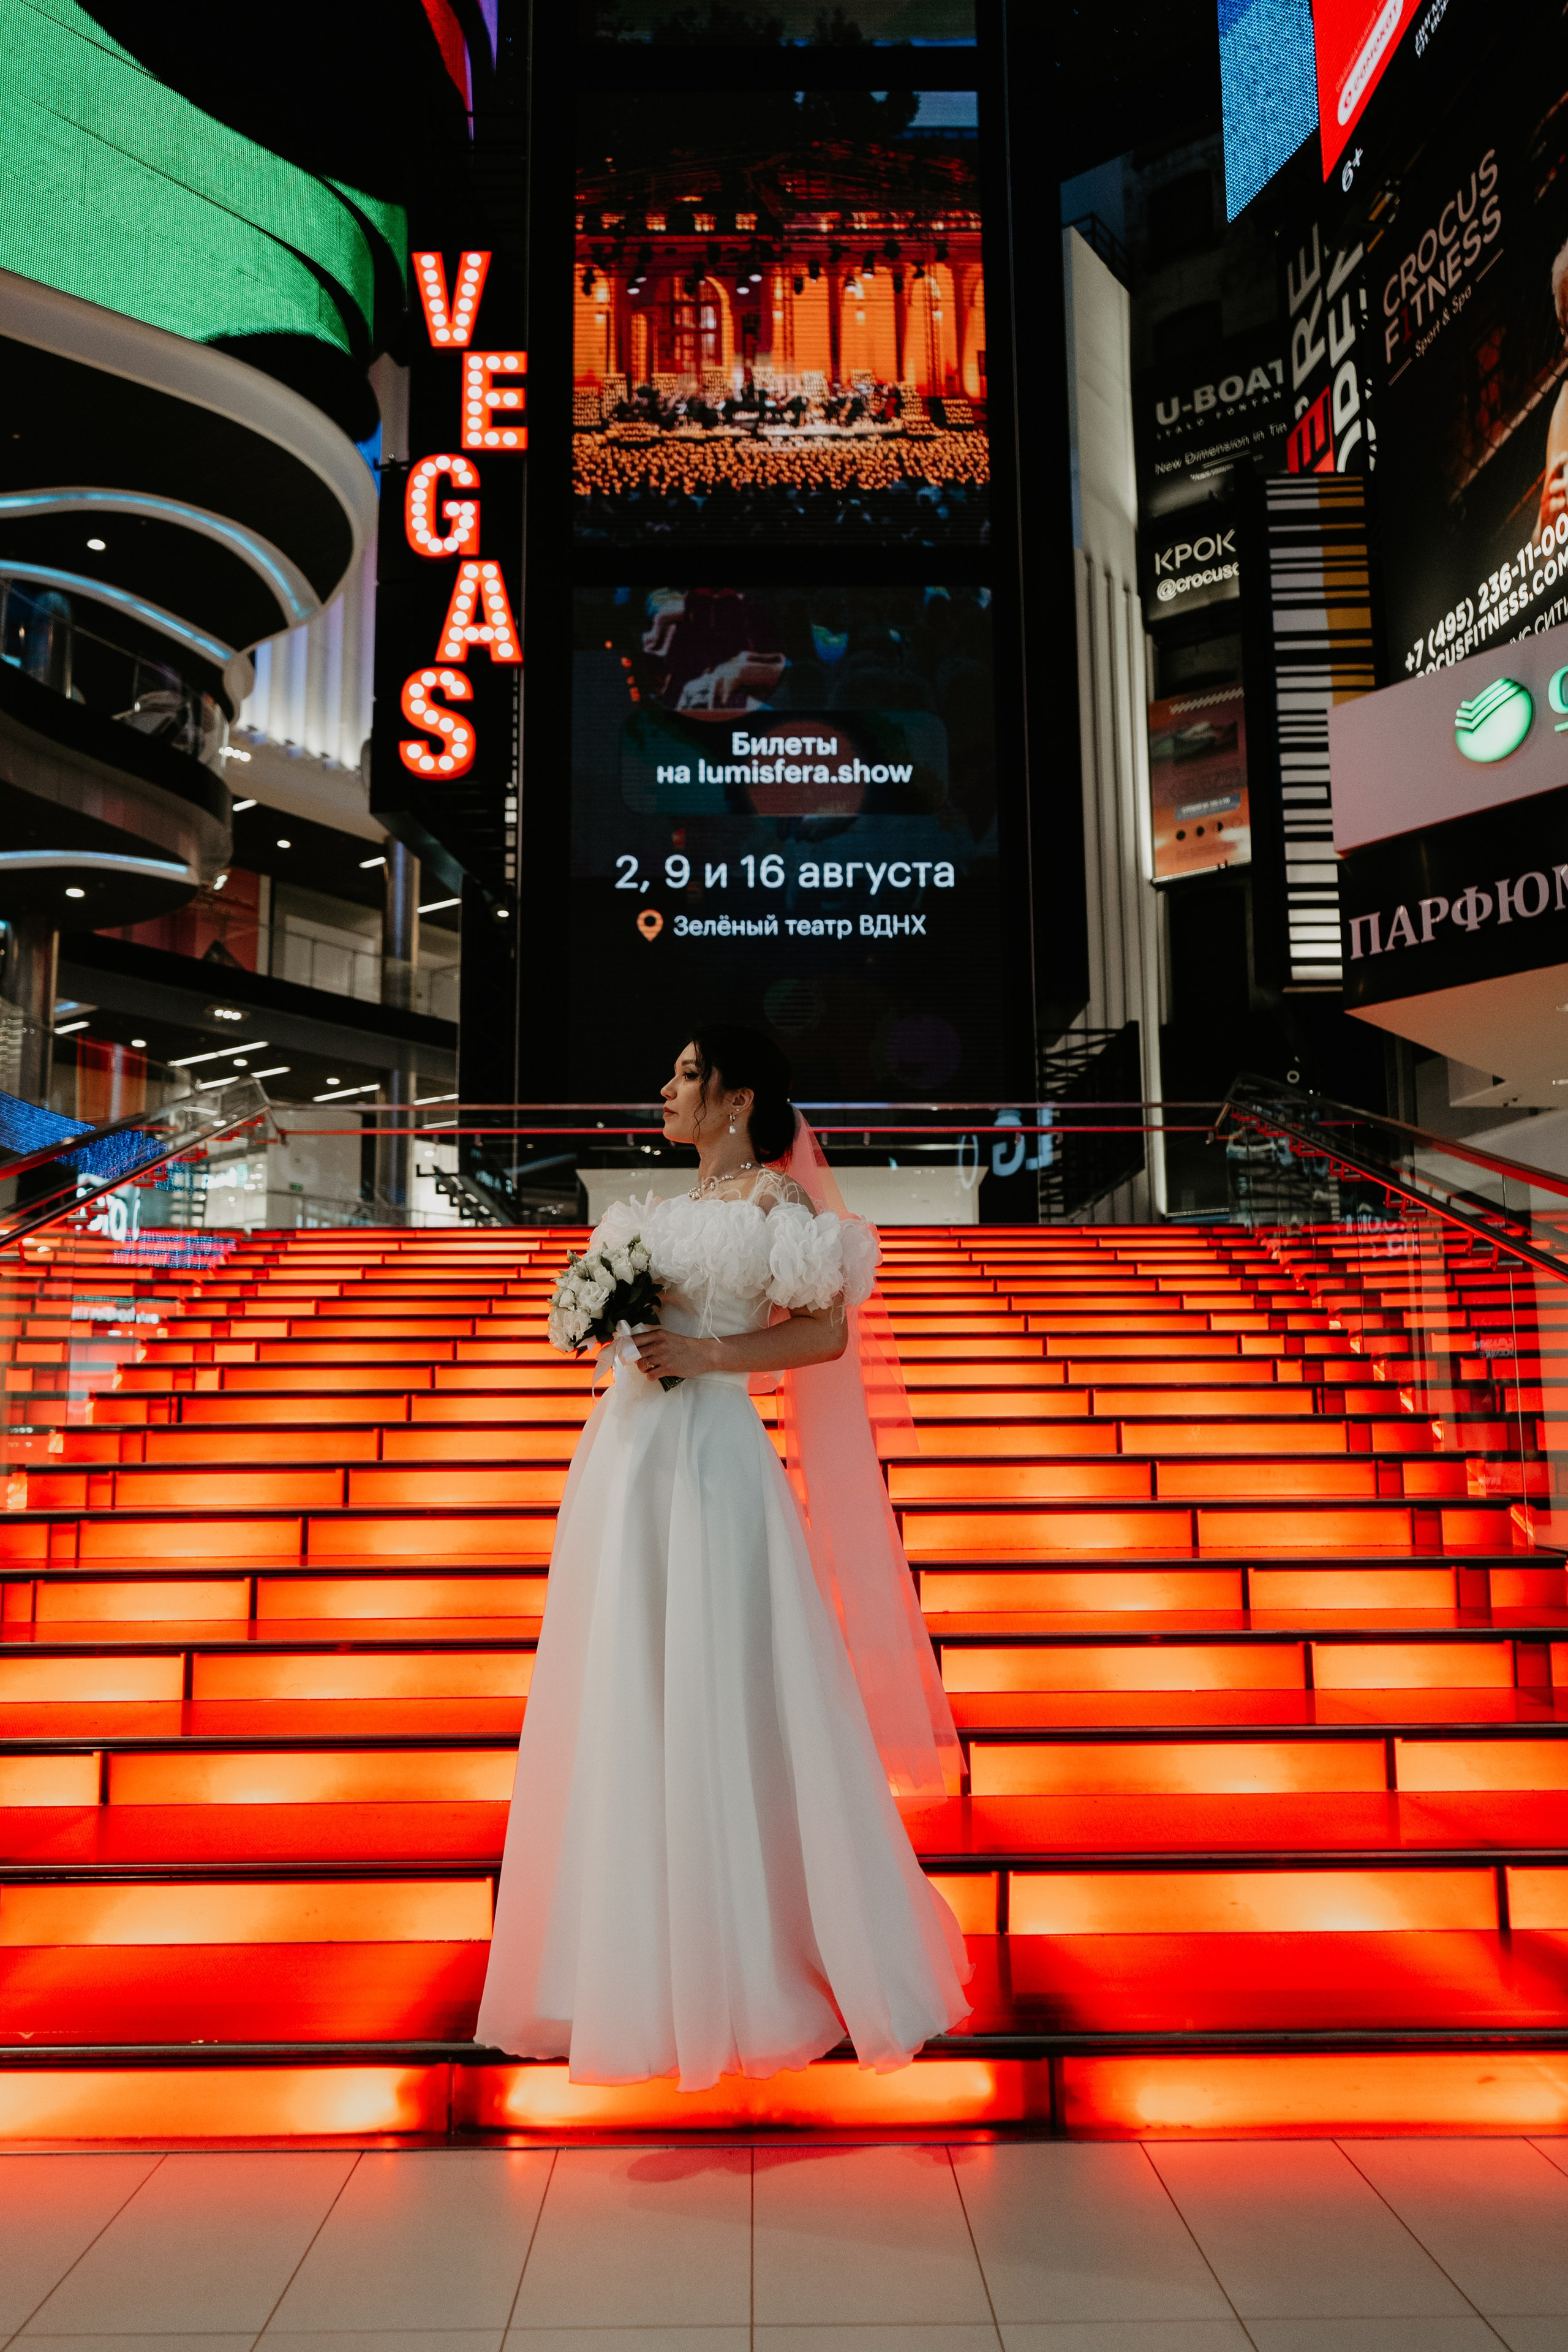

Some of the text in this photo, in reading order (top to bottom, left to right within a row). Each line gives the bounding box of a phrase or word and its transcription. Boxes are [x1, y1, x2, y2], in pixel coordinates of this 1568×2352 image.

[1341, 147, 1363, 192] 6+
[1383, 148, 1498, 317] CROCUS
[1415, 284, 1472, 358] Sport & Spa
[1156, 417, 1205, 440] ITALO
[1155, 458, 1182, 475] New
[1185, 435, 1250, 466] Dimension
[1253, 430, 1265, 442] in
[399, 251, 527, 780] VEGAS
[1404, 512, 1568, 673] +7 (495) 236-11-00
[731, 732, 838, 756] Билеты
[656, 758, 914, 784] на lumisfera.show
[614, 854, 956, 895] 2, 9 и 16 августа
[673, 914, 927, 940] Зелёный театр ВДНХ
